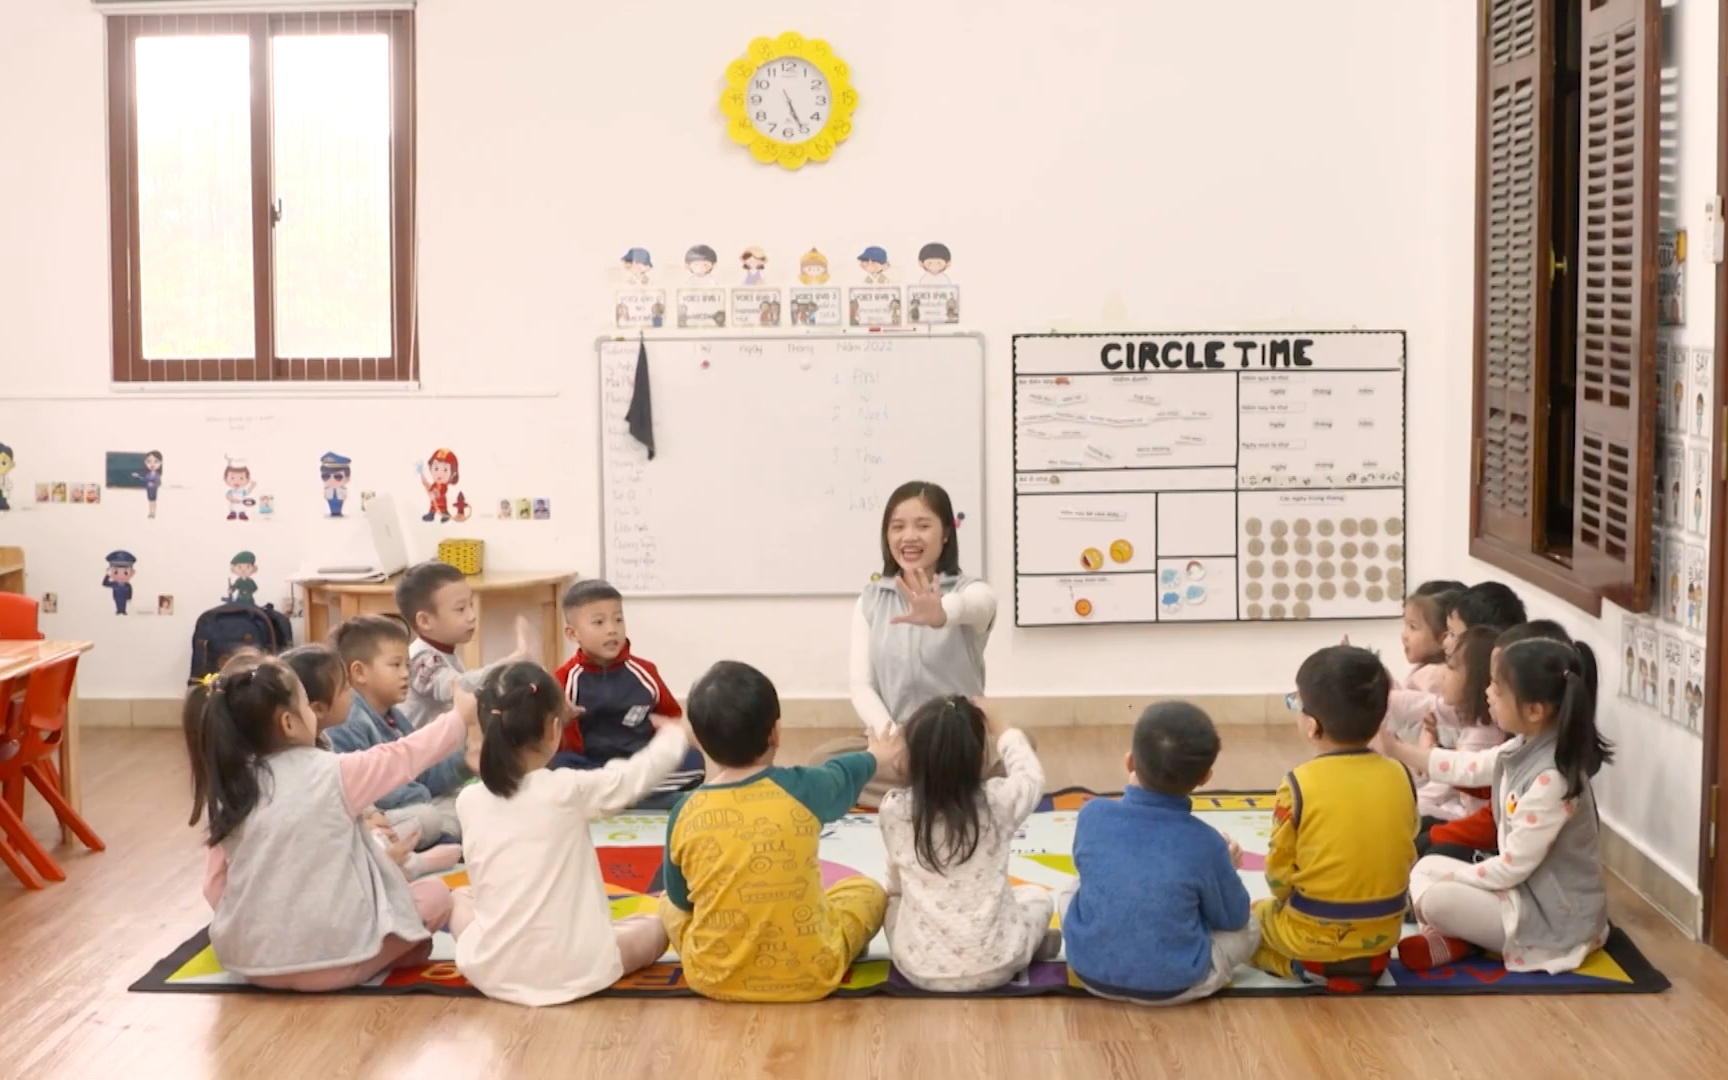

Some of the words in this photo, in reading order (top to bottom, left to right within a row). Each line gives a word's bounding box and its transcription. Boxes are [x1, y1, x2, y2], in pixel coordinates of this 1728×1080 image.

[781, 62, 797, 72] 12
[767, 68, 776, 77] 11
[755, 80, 770, 90] 10
[810, 80, 822, 90] 2
[750, 95, 762, 106] 9
[815, 96, 826, 106] 3
[756, 110, 767, 122] 8
[810, 112, 820, 122] 4
[768, 122, 778, 134] 7
[782, 128, 794, 138] 6
[800, 123, 810, 134] 5
[1100, 341, 1226, 370] CIRCLE
[1233, 339, 1314, 368] TIME
